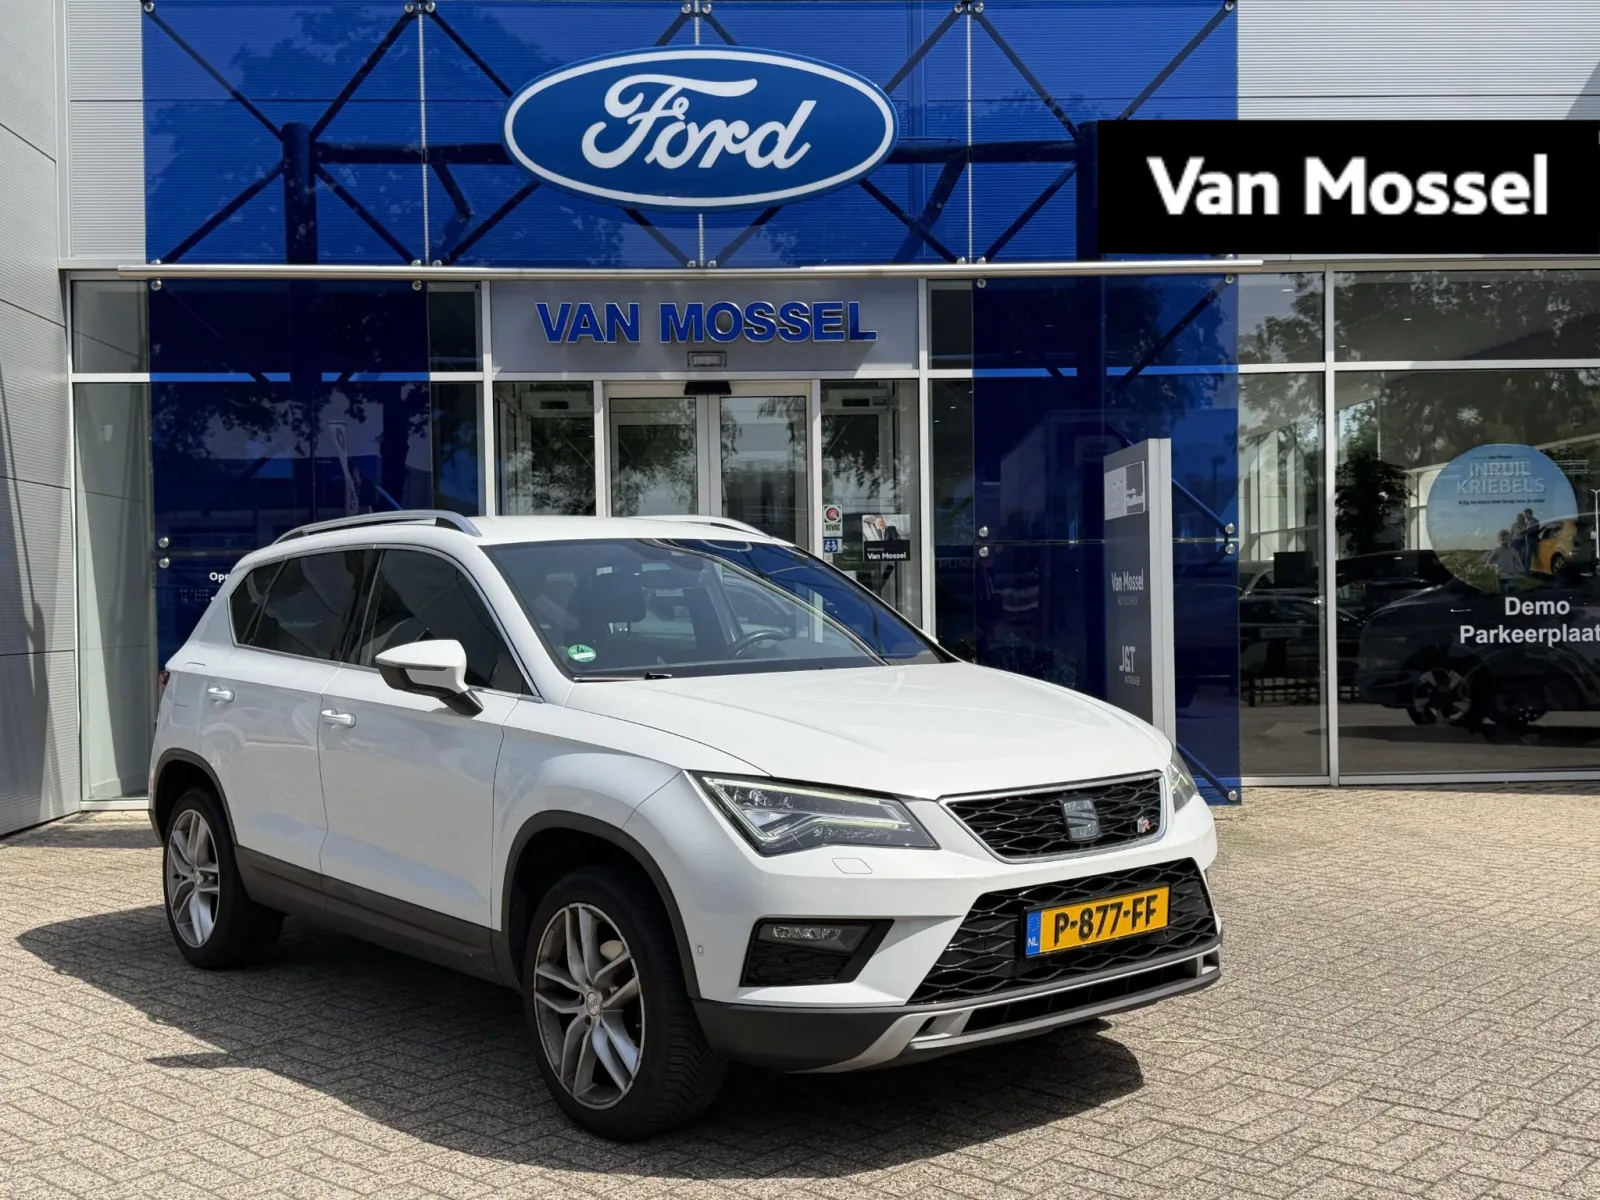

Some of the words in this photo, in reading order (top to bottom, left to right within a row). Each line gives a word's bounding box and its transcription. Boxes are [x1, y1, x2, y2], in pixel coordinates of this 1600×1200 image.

[581, 74, 816, 170] Ford
[536, 302, 641, 343] VAN
[660, 301, 878, 343] MOSSEL
[1456, 477, 1547, 495] KRIEBELS
[866, 552, 881, 560] Van
[881, 551, 907, 560] Mossel
[1111, 572, 1123, 592] Van
[1123, 568, 1144, 591] Mossel
[1505, 597, 1570, 616] Demo
[1054, 893, 1159, 947] P-877-FF
[1027, 937, 1039, 947] NL
